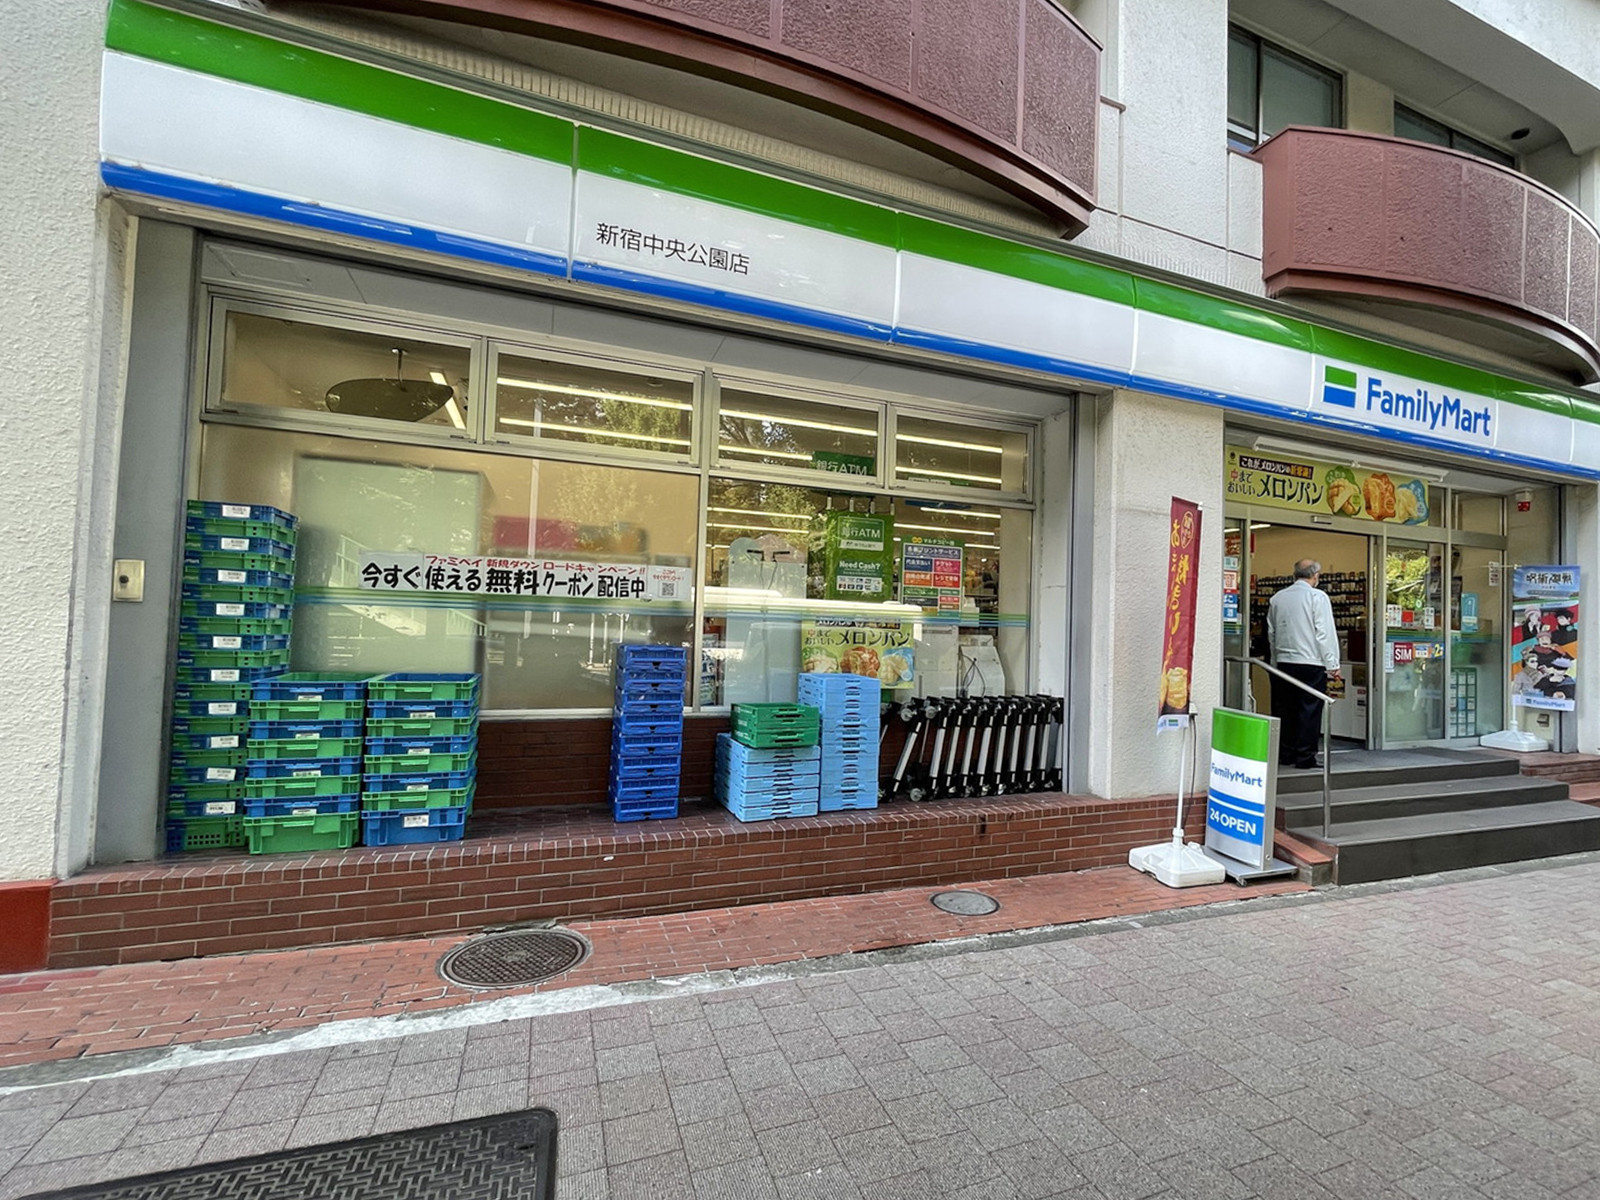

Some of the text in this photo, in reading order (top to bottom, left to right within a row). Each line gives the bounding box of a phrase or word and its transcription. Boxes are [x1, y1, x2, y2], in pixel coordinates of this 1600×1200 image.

[596, 222, 750, 275] 新宿中央公園店
[1366, 377, 1491, 437] FamilyMart
[1227, 482, 1256, 496] おいしい
[1256, 474, 1324, 505] メロンパン
[837, 629, 910, 647] メロンパン
[1395, 648, 1412, 661] SIM
[1211, 763, 1263, 788] FamilyMart
